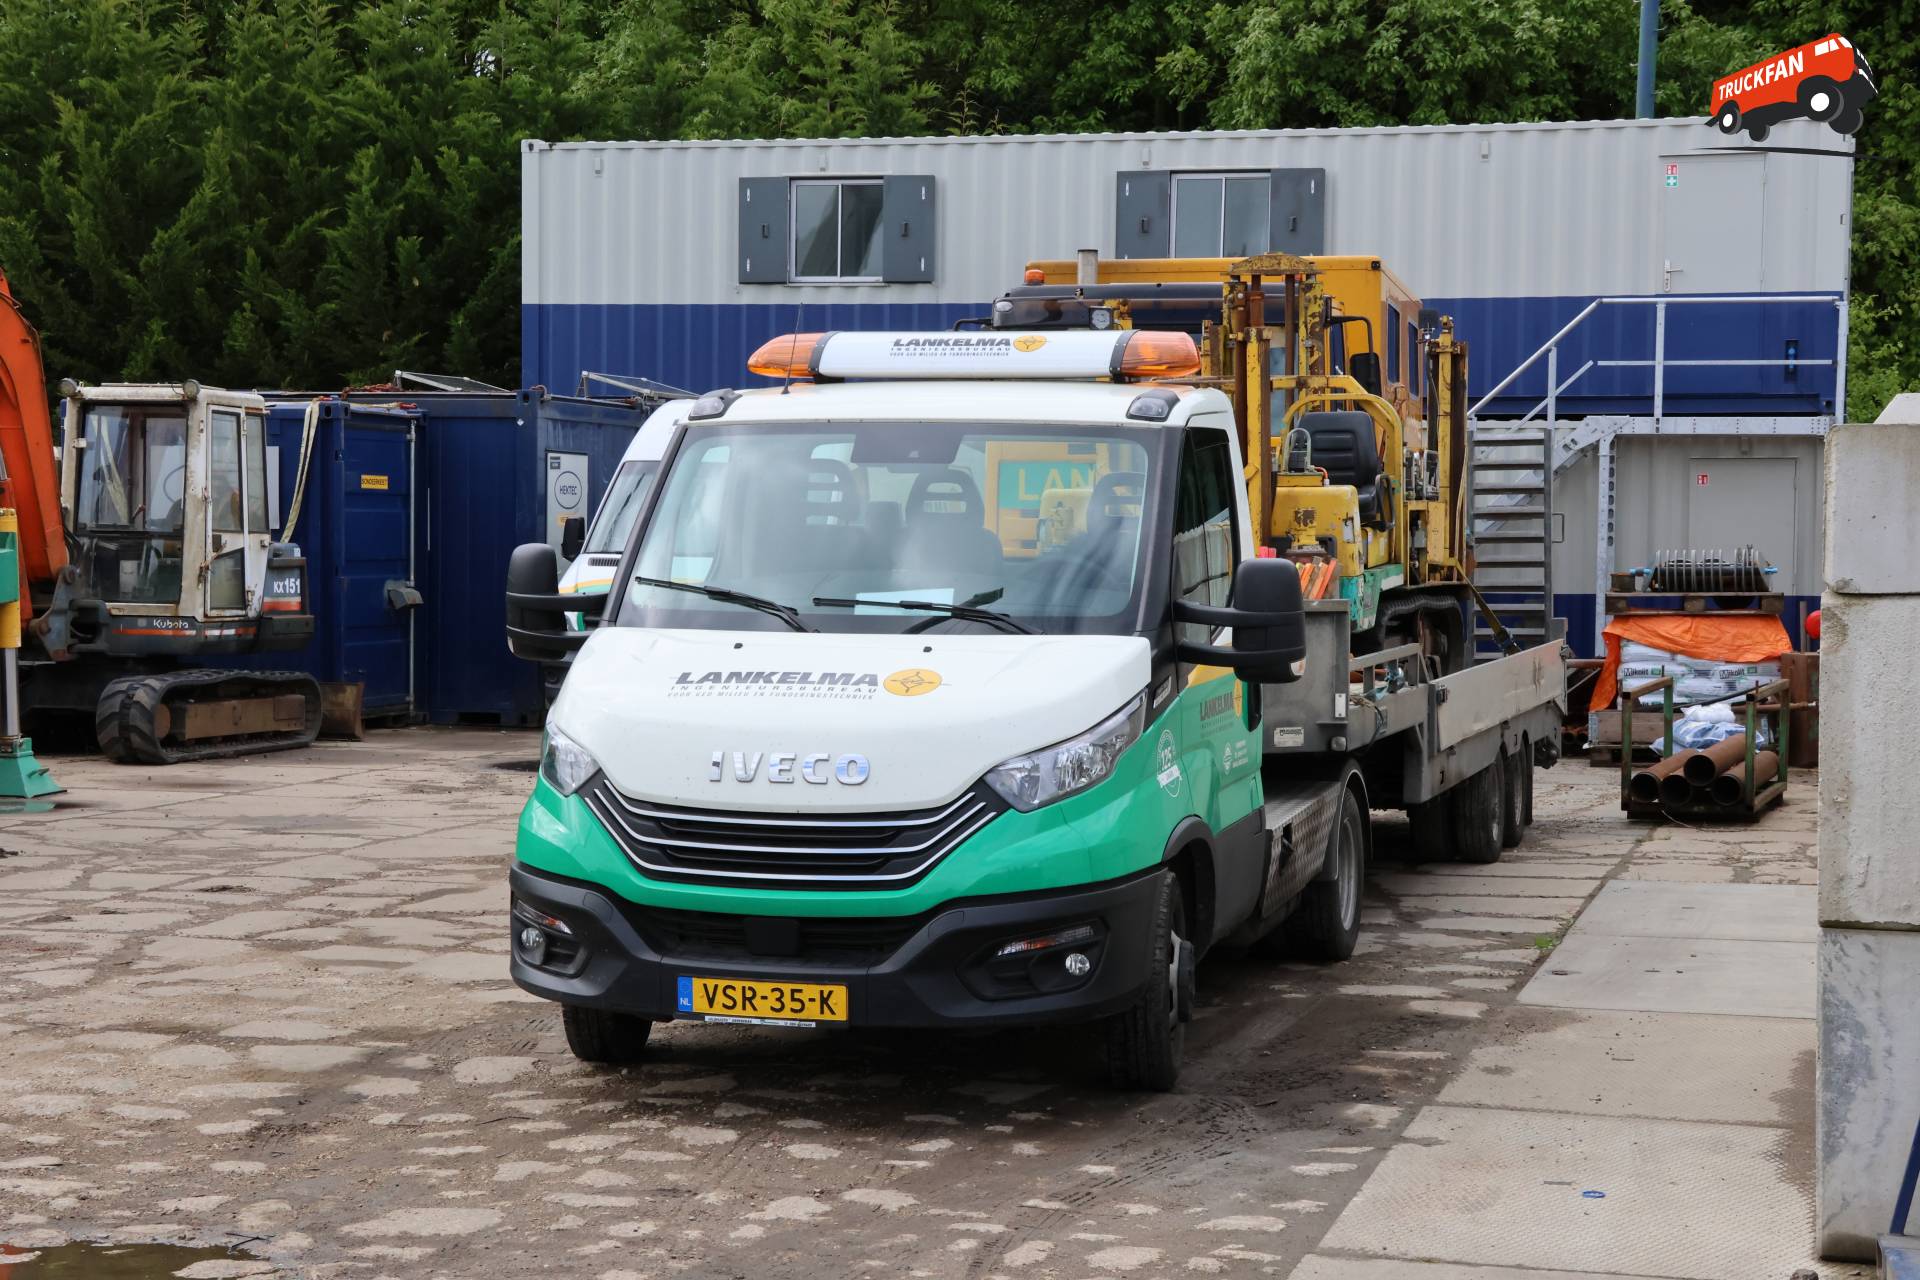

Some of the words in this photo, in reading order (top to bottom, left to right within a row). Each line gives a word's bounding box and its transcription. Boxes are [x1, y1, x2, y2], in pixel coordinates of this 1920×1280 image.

[893, 338, 1011, 347] LANKELMA
[273, 577, 301, 594] KX151
[153, 619, 189, 629] Kubota
[675, 671, 879, 687] LANKELMA
[671, 685, 877, 694] INGENIEURSBUREAU
[1200, 691, 1234, 722] LANKELMA
[710, 751, 870, 786] IVECO
[680, 997, 692, 1006] NL
[702, 983, 837, 1016] VSR-35-K
